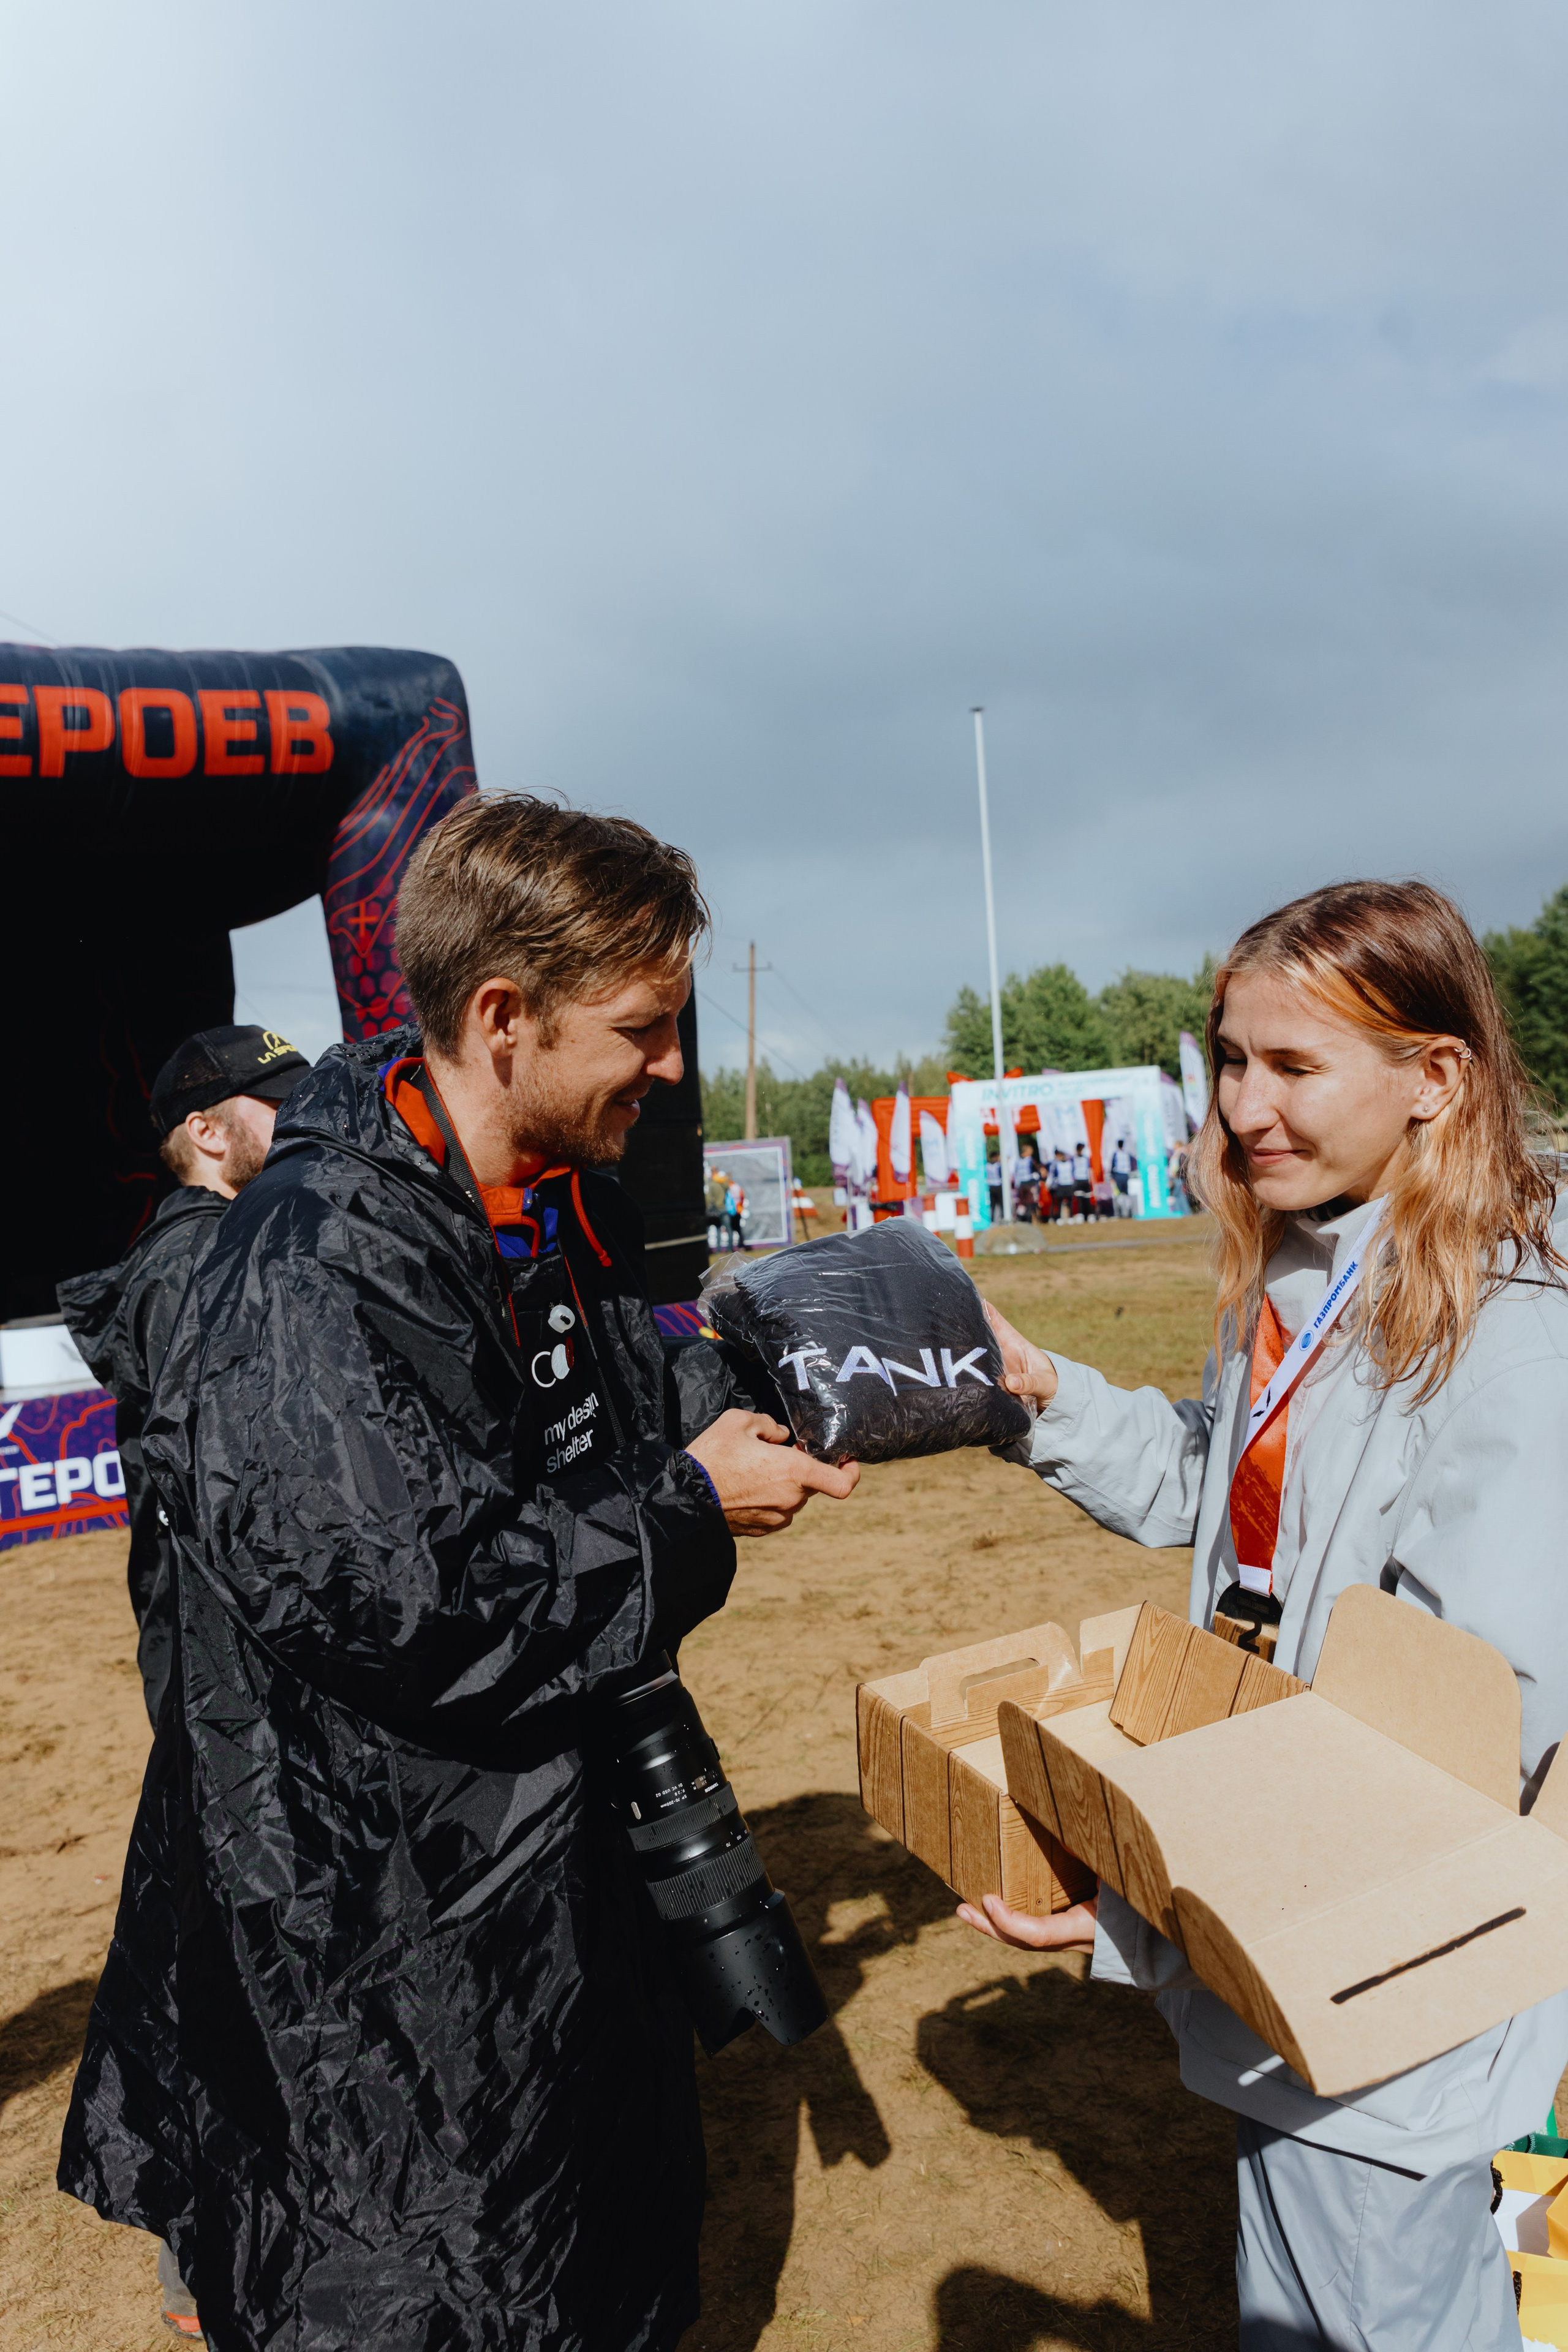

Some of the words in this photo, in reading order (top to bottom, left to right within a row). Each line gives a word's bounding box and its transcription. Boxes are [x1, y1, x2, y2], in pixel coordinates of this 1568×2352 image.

[982, 1083, 1054, 1101] INVITRO
[1313, 1261, 1359, 1329] ГАЗПРОМБАНК
[778, 1346, 995, 1396] TANK
[545, 1418, 567, 1446] my
[567, 1392, 600, 1431] desin
[546, 1429, 594, 1473] shelter
